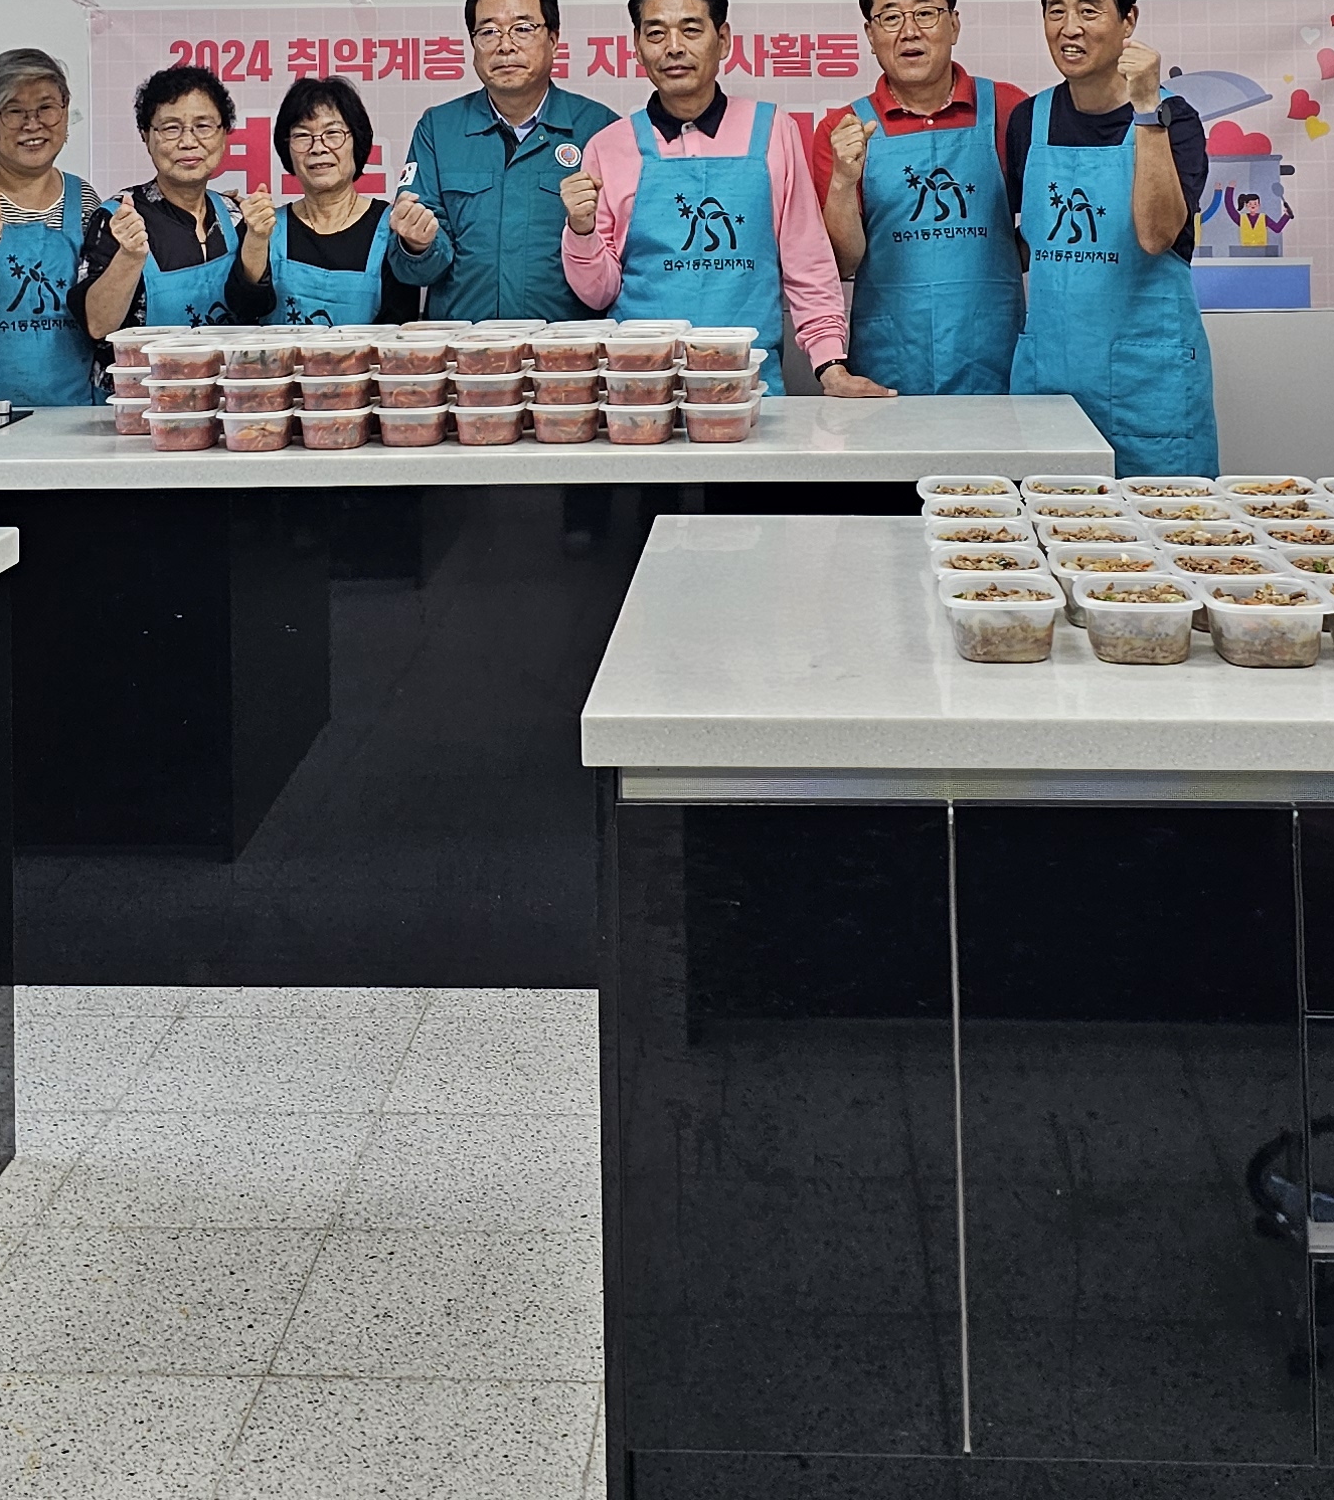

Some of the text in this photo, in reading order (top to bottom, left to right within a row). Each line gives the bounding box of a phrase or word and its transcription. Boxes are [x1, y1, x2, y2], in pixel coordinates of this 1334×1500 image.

[169, 40, 273, 82] 2024
[287, 36, 466, 81] 취약계층
[891, 226, 988, 243] 연수1동주민자치회
[663, 258, 755, 272] 연수1동주민자치회
[1034, 249, 1119, 265] 연수1동주민자치회
